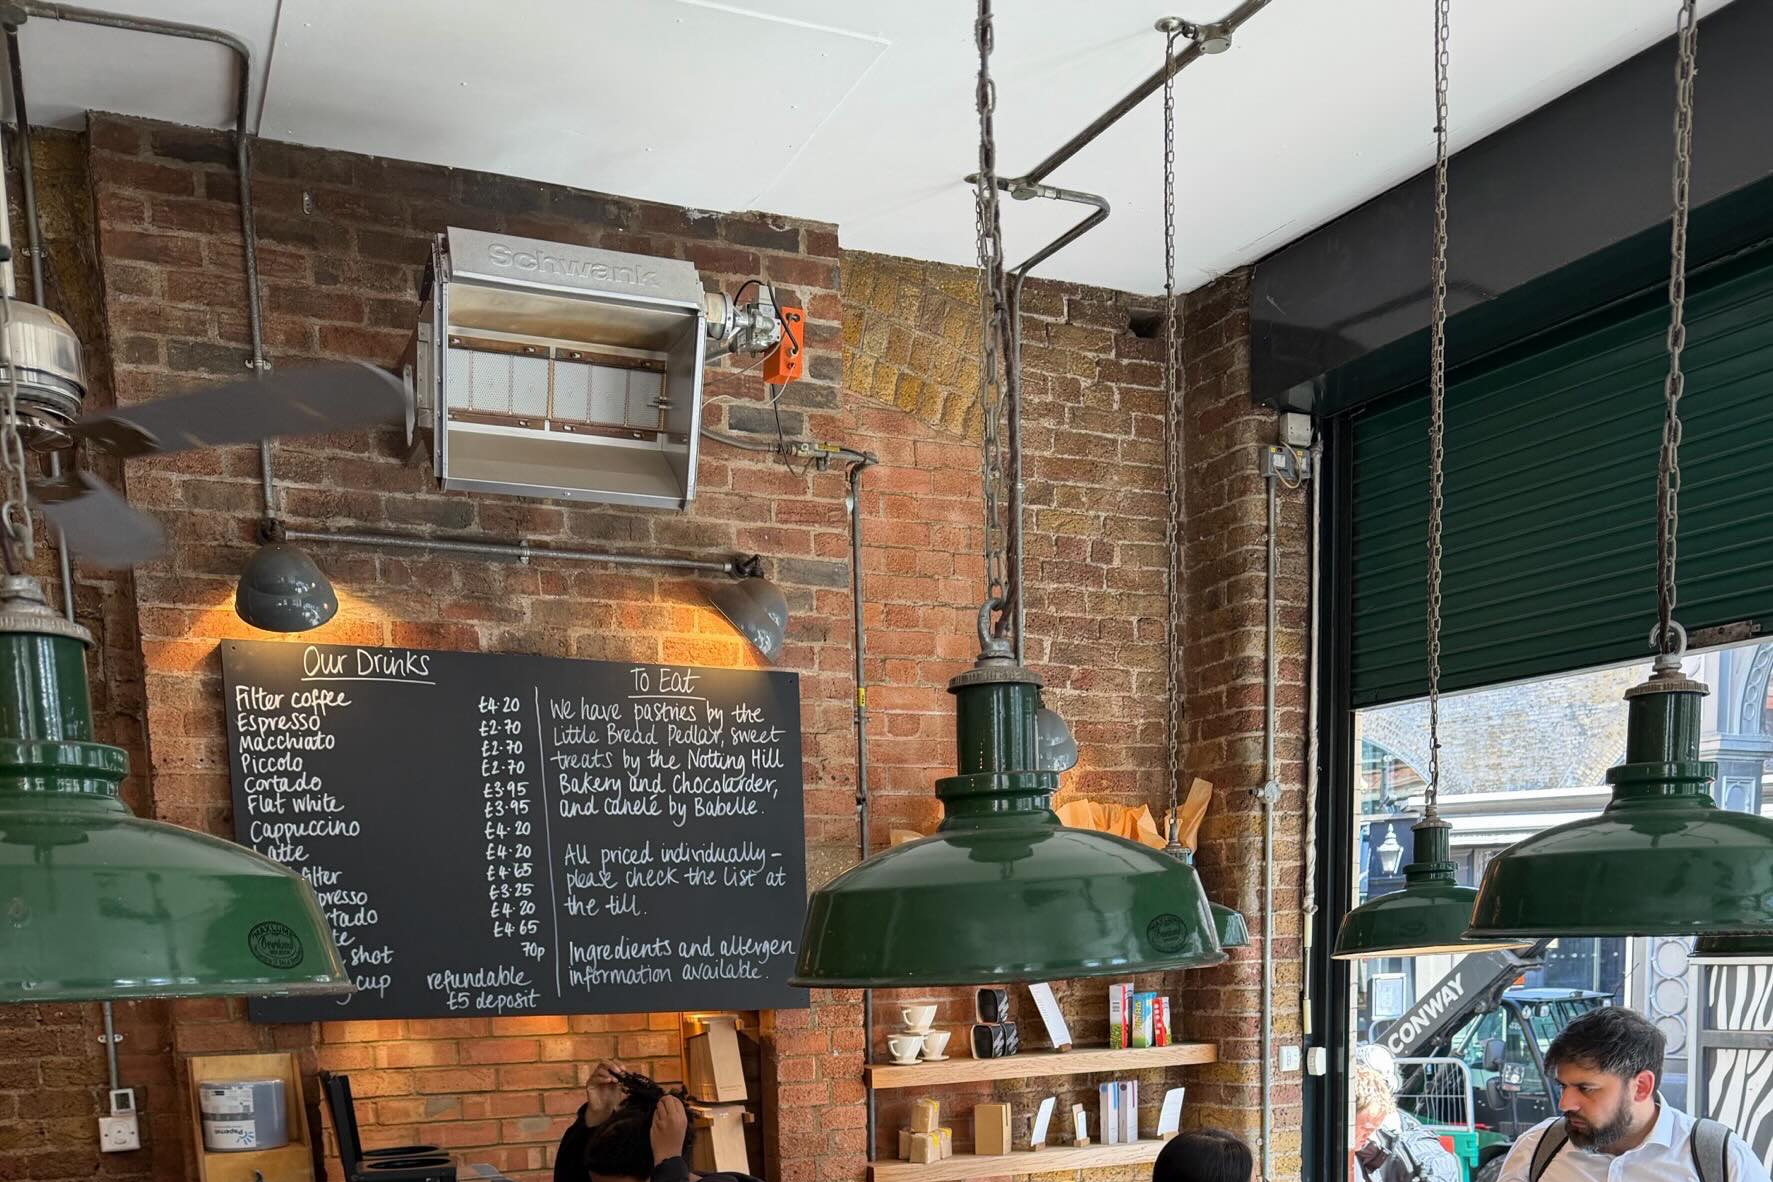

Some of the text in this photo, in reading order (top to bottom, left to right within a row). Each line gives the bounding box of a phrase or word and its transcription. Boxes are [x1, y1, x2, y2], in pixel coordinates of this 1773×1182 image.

[487, 243, 662, 288] Schwank
[303, 646, 431, 677] Our Drinks
[630, 667, 700, 694] To Eat
[235, 685, 352, 716] Filter coffee
[237, 714, 320, 738] Espresso
[550, 696, 765, 732] We have pastries by the
[239, 731, 335, 753] Macchiato
[553, 726, 599, 746] Little
[607, 723, 658, 746] Bread
[731, 725, 786, 744] sweet
[241, 752, 303, 774] Piccolo
[550, 748, 784, 779] treats by the Notting Hill
[244, 772, 322, 793] Cortado
[559, 773, 622, 800] Bakery
[629, 773, 666, 793] and
[247, 793, 345, 815] Flat white
[559, 796, 599, 817] and
[669, 796, 686, 827] by
[250, 817, 361, 844] Cappuccino
[564, 842, 591, 866] All
[600, 840, 654, 872] priced
[566, 864, 787, 895] please check the list at
[314, 890, 368, 906] presso
[564, 895, 600, 916] the
[325, 907, 378, 925] rtado
[351, 949, 394, 966] shot
[521, 942, 545, 961] 70p
[569, 935, 795, 966] Ingredients and allergen
[357, 973, 392, 999] cup
[427, 965, 532, 991] refundable
[569, 964, 673, 992] information
[448, 990, 541, 1015] £5 deposit
[1388, 972, 1464, 1054] CONWAY
